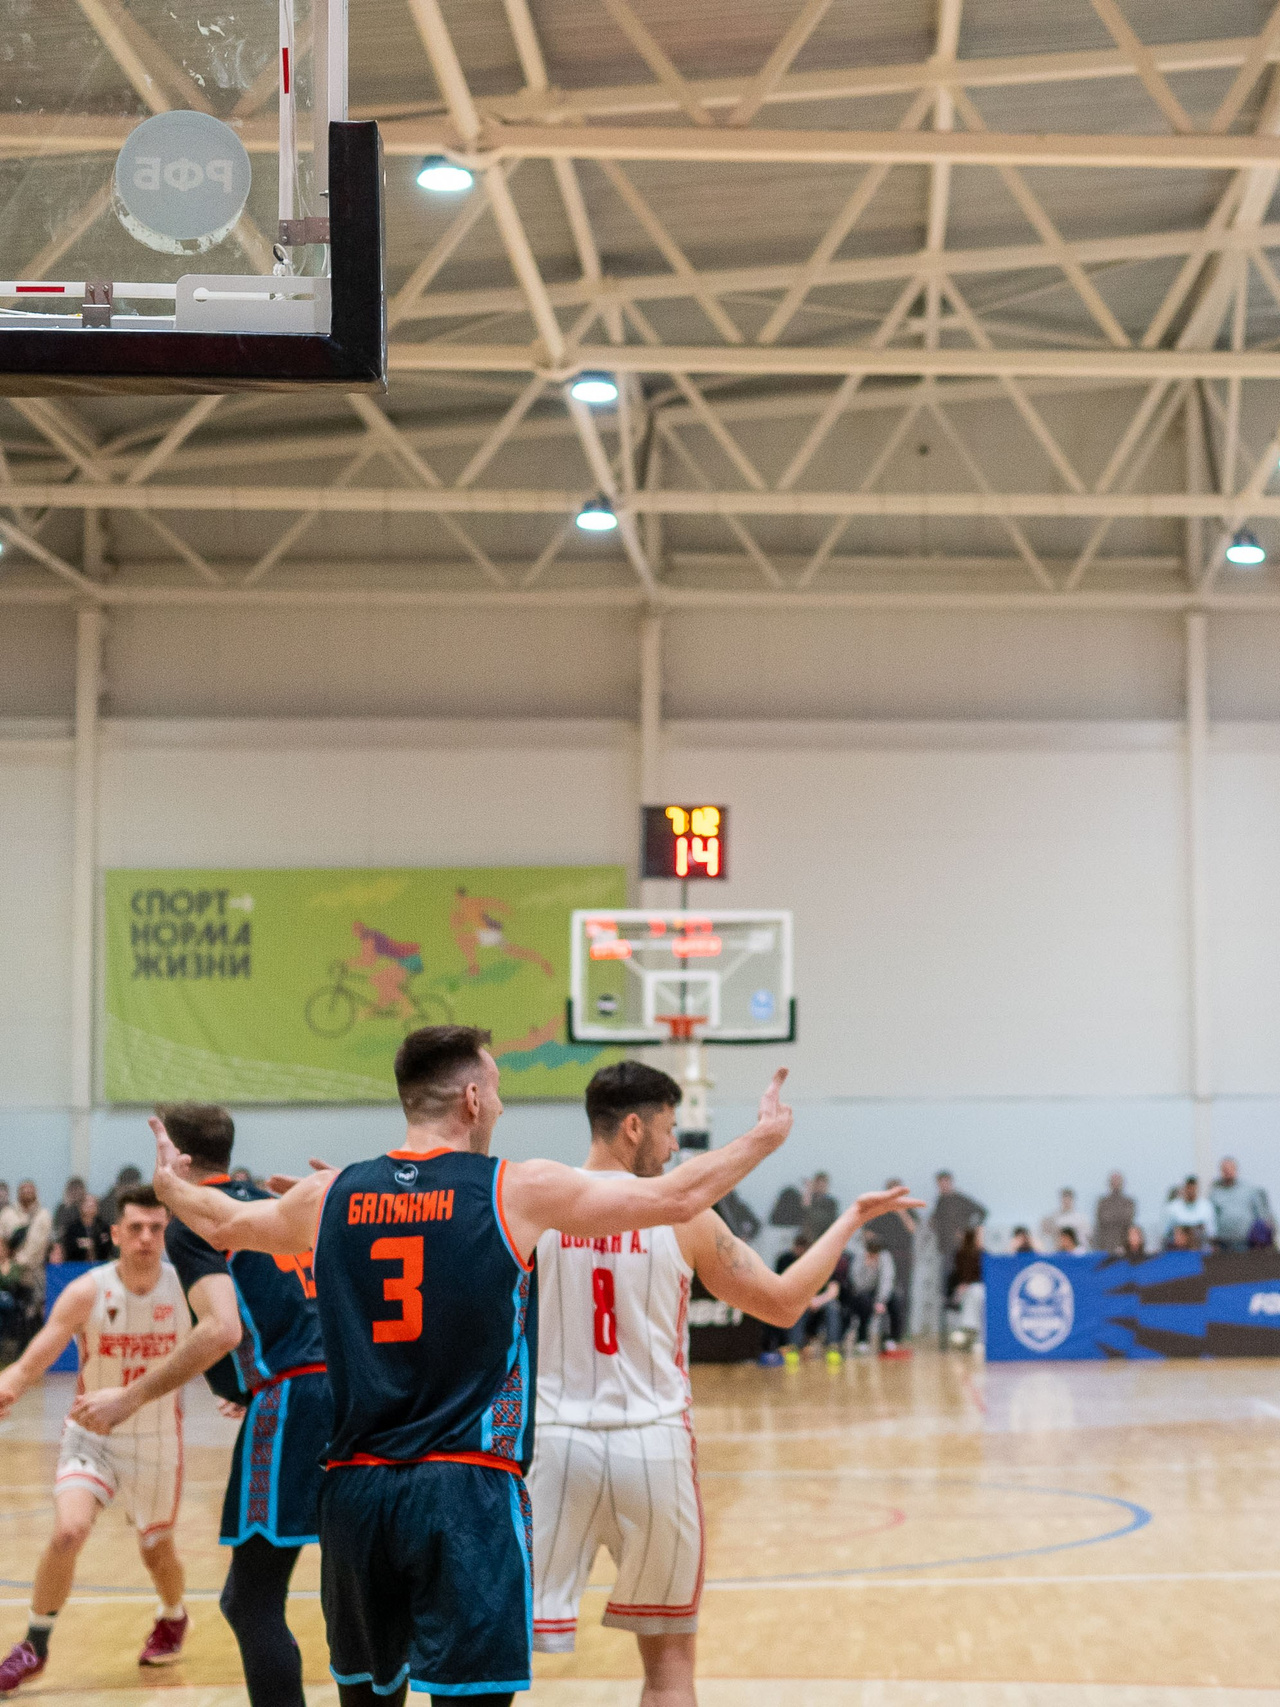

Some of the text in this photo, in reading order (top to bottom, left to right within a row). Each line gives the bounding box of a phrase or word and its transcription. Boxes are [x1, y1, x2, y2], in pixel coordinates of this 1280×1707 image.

[675, 836, 721, 877] 14
[131, 888, 229, 917] СПОРТ
[131, 920, 251, 947] НОРМА
[132, 953, 251, 979] ЖИЗНИ
[347, 1189, 455, 1226] БАЛЯКИН
[370, 1235, 425, 1344] 3
[592, 1267, 618, 1355] 8
